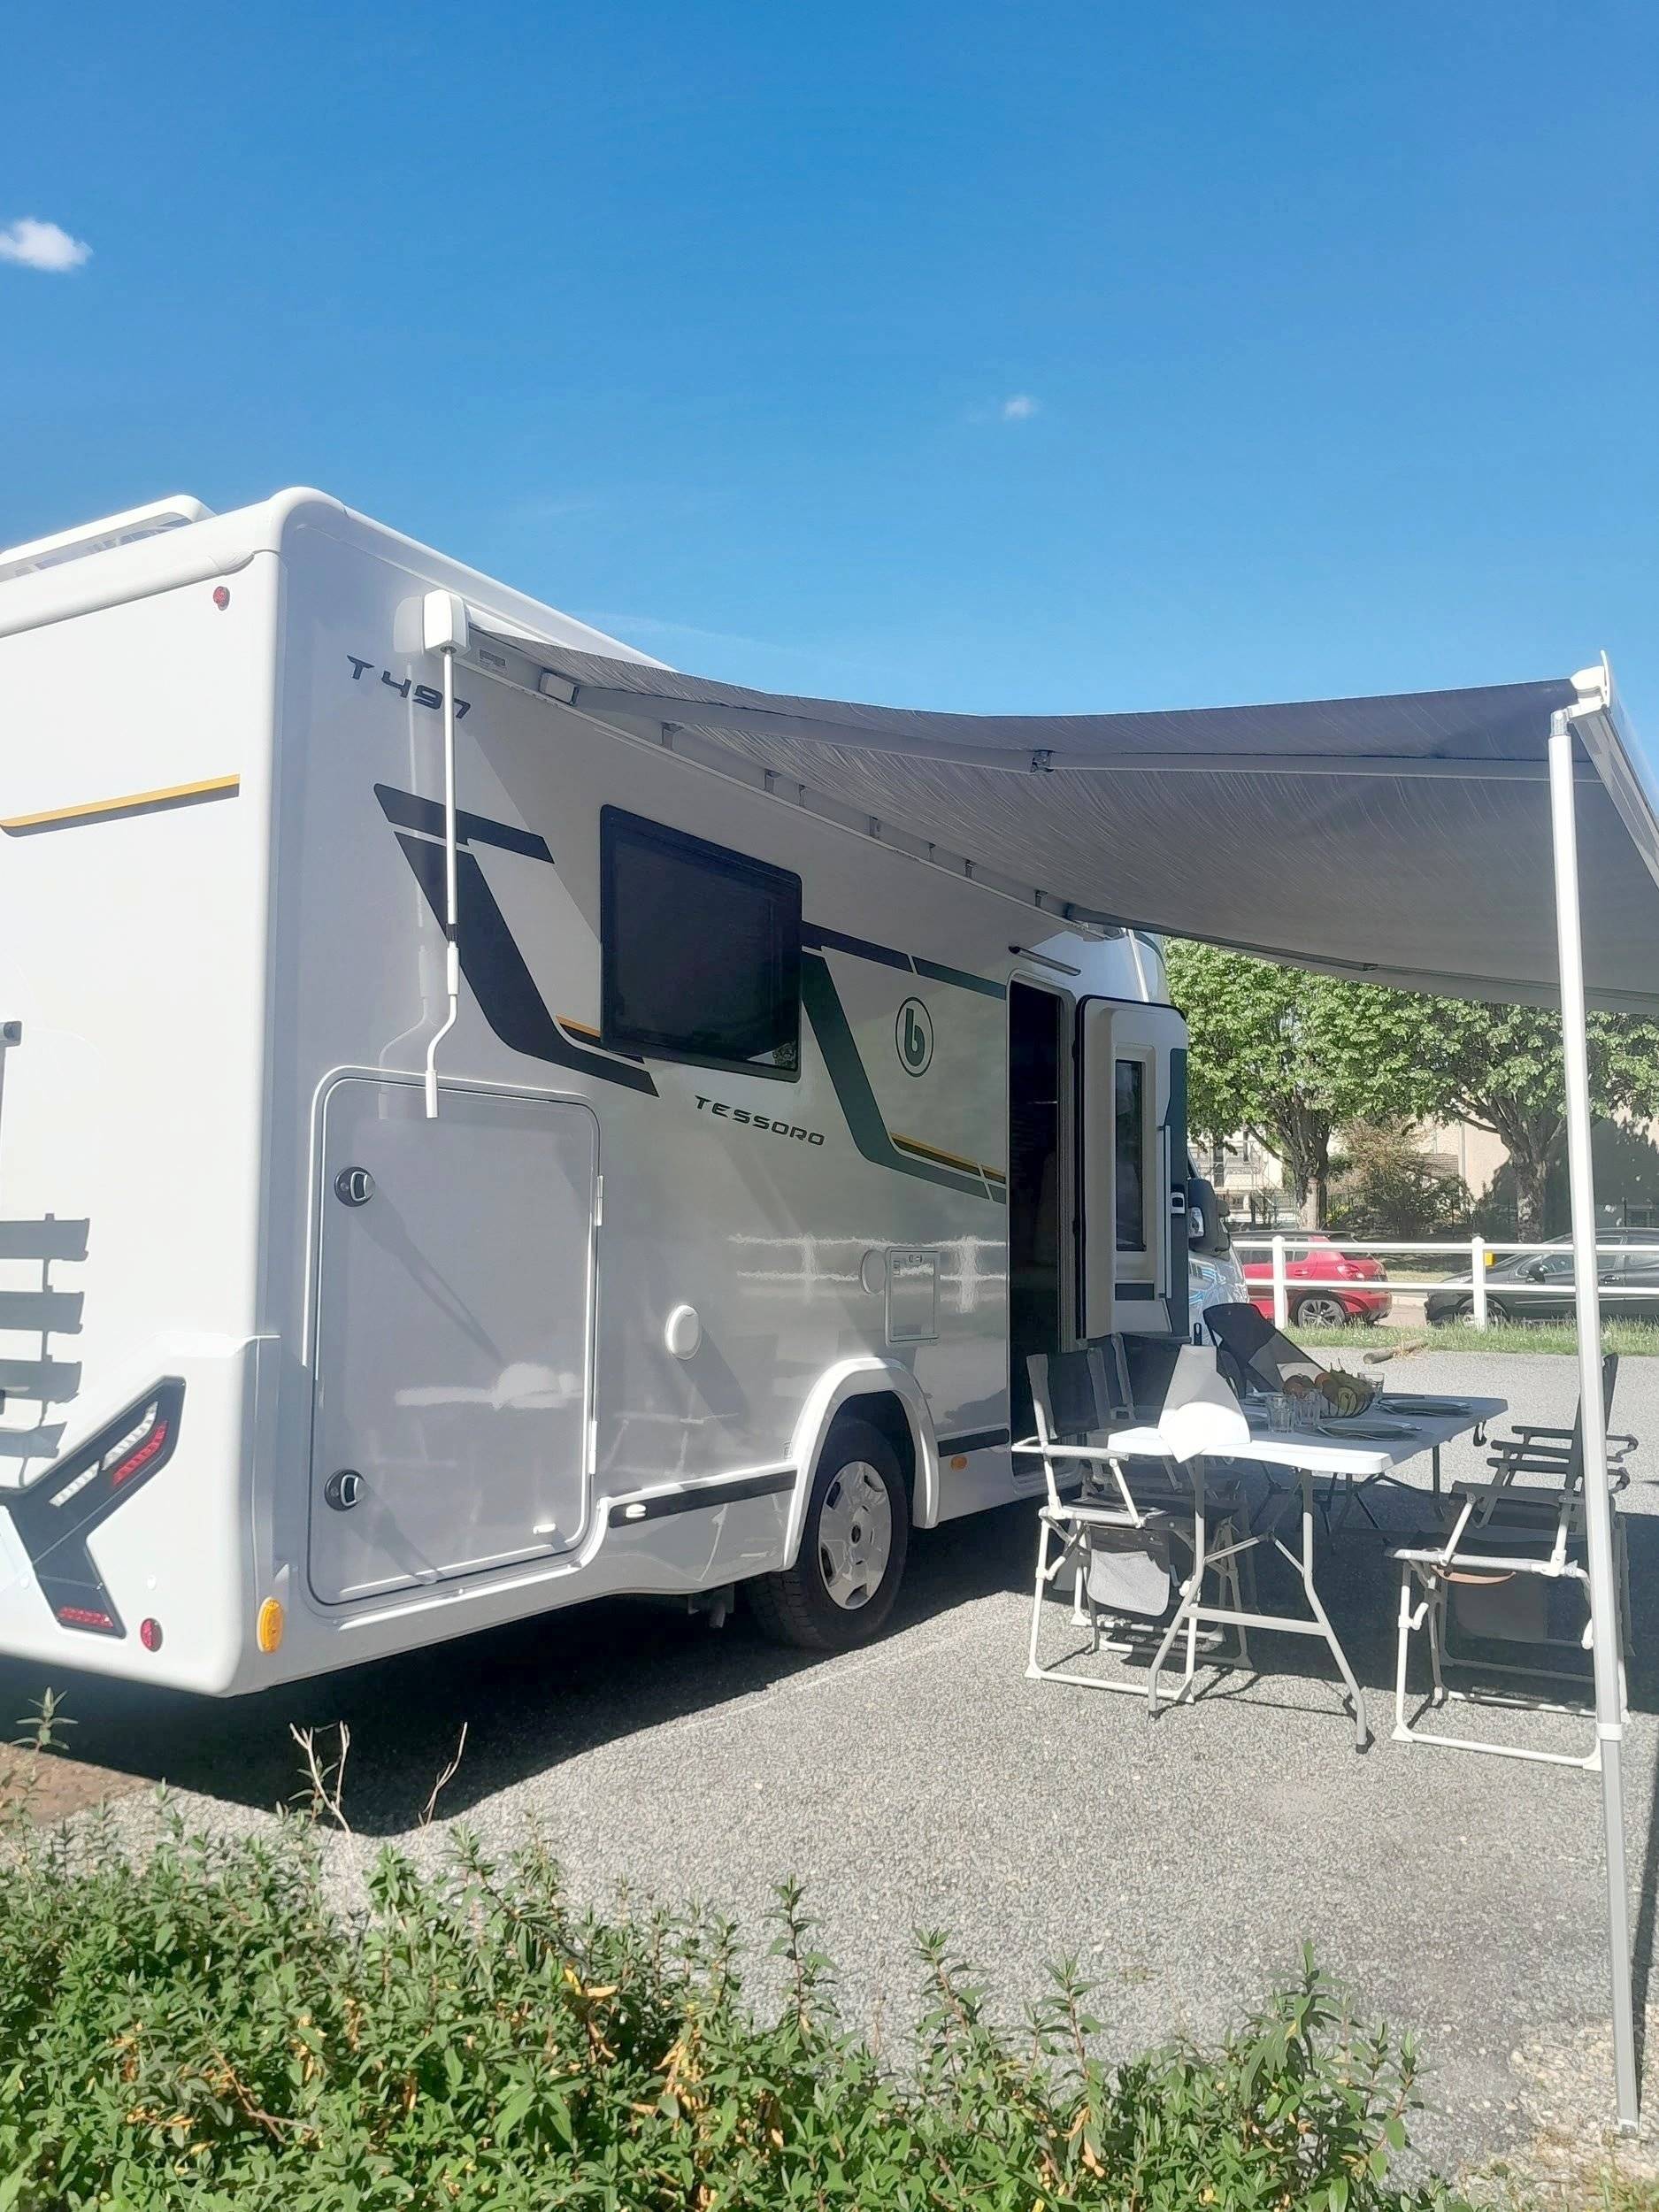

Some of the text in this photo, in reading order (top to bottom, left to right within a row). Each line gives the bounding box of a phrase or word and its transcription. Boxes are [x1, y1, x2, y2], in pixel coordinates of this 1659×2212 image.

[347, 655, 471, 718] T 497
[904, 1008, 926, 1066] b
[695, 1094, 825, 1146] TESSORO
